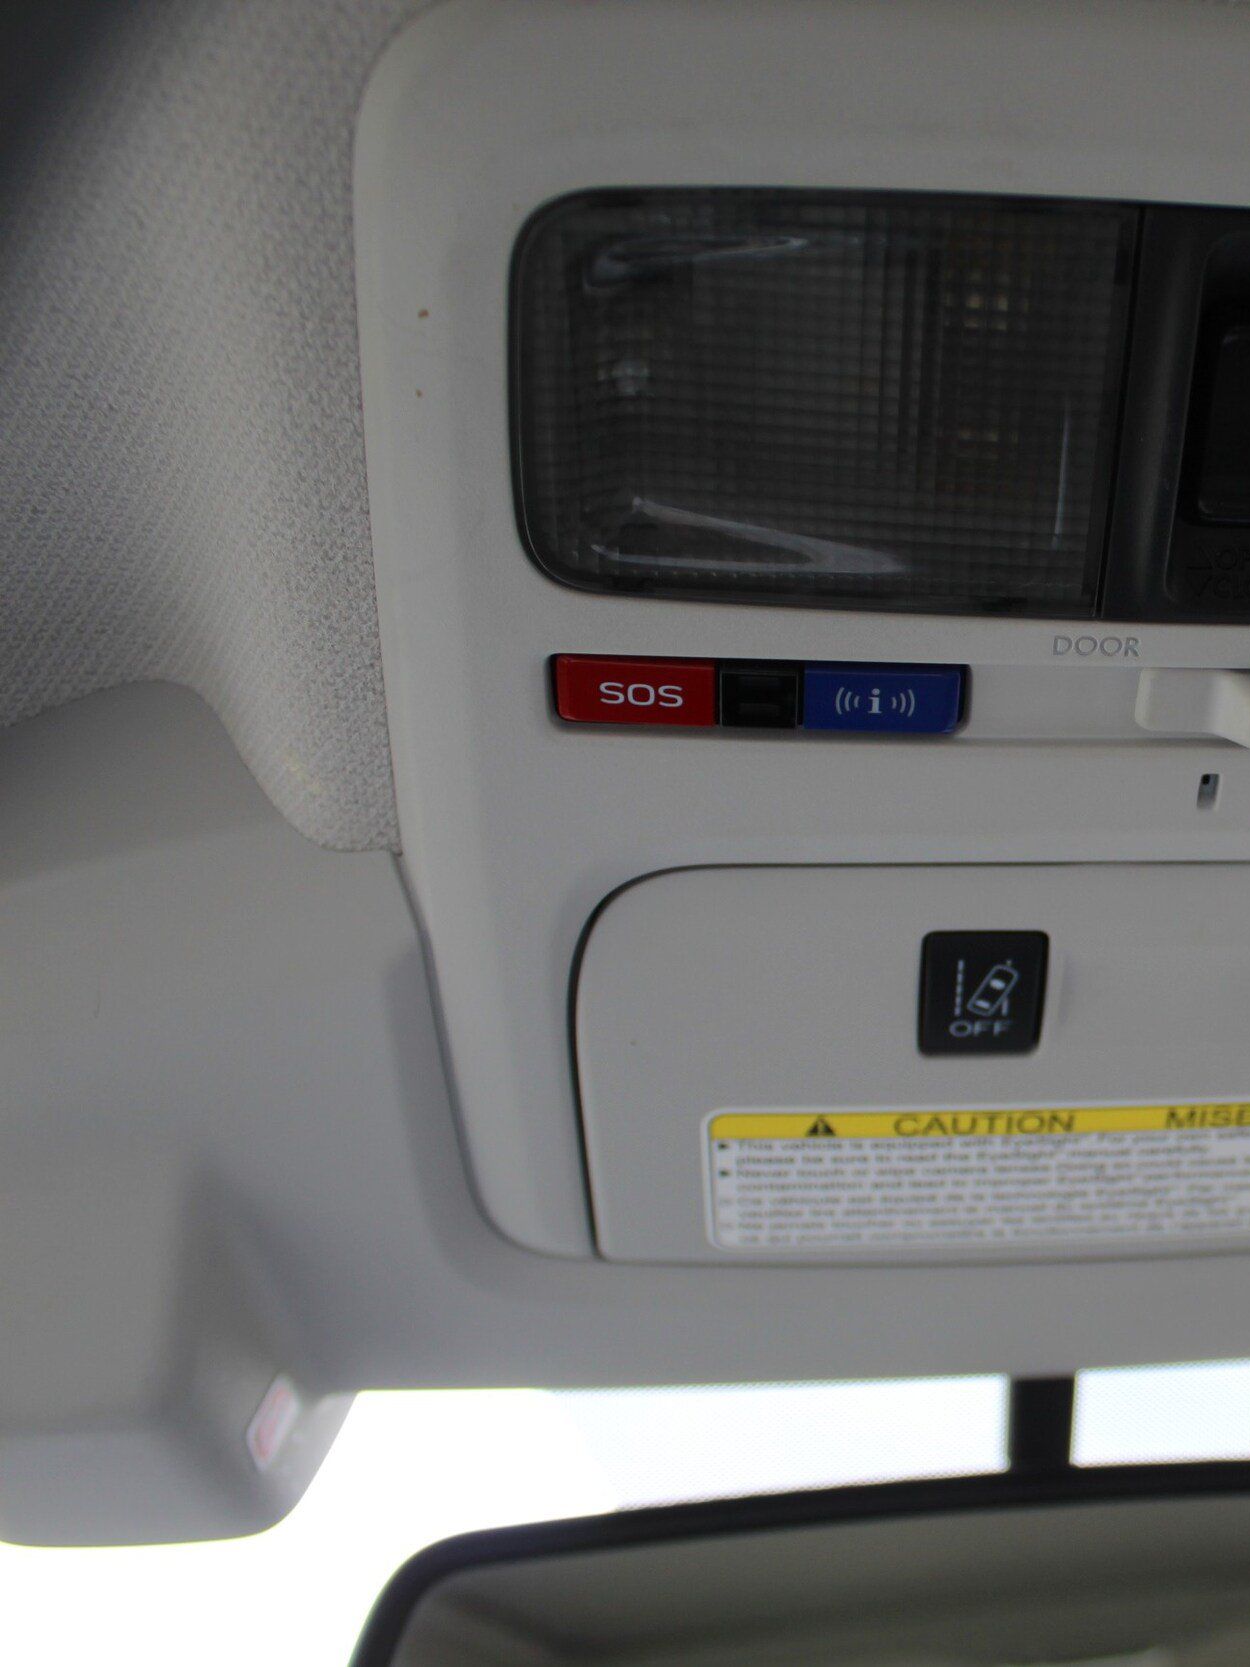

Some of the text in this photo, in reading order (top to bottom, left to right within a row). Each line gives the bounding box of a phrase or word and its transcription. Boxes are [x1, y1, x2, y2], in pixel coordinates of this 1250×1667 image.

[1052, 635, 1141, 657] DOOR
[599, 681, 684, 708] SOS
[948, 1019, 1016, 1038] OFF
[892, 1110, 1077, 1137] CAUTION
